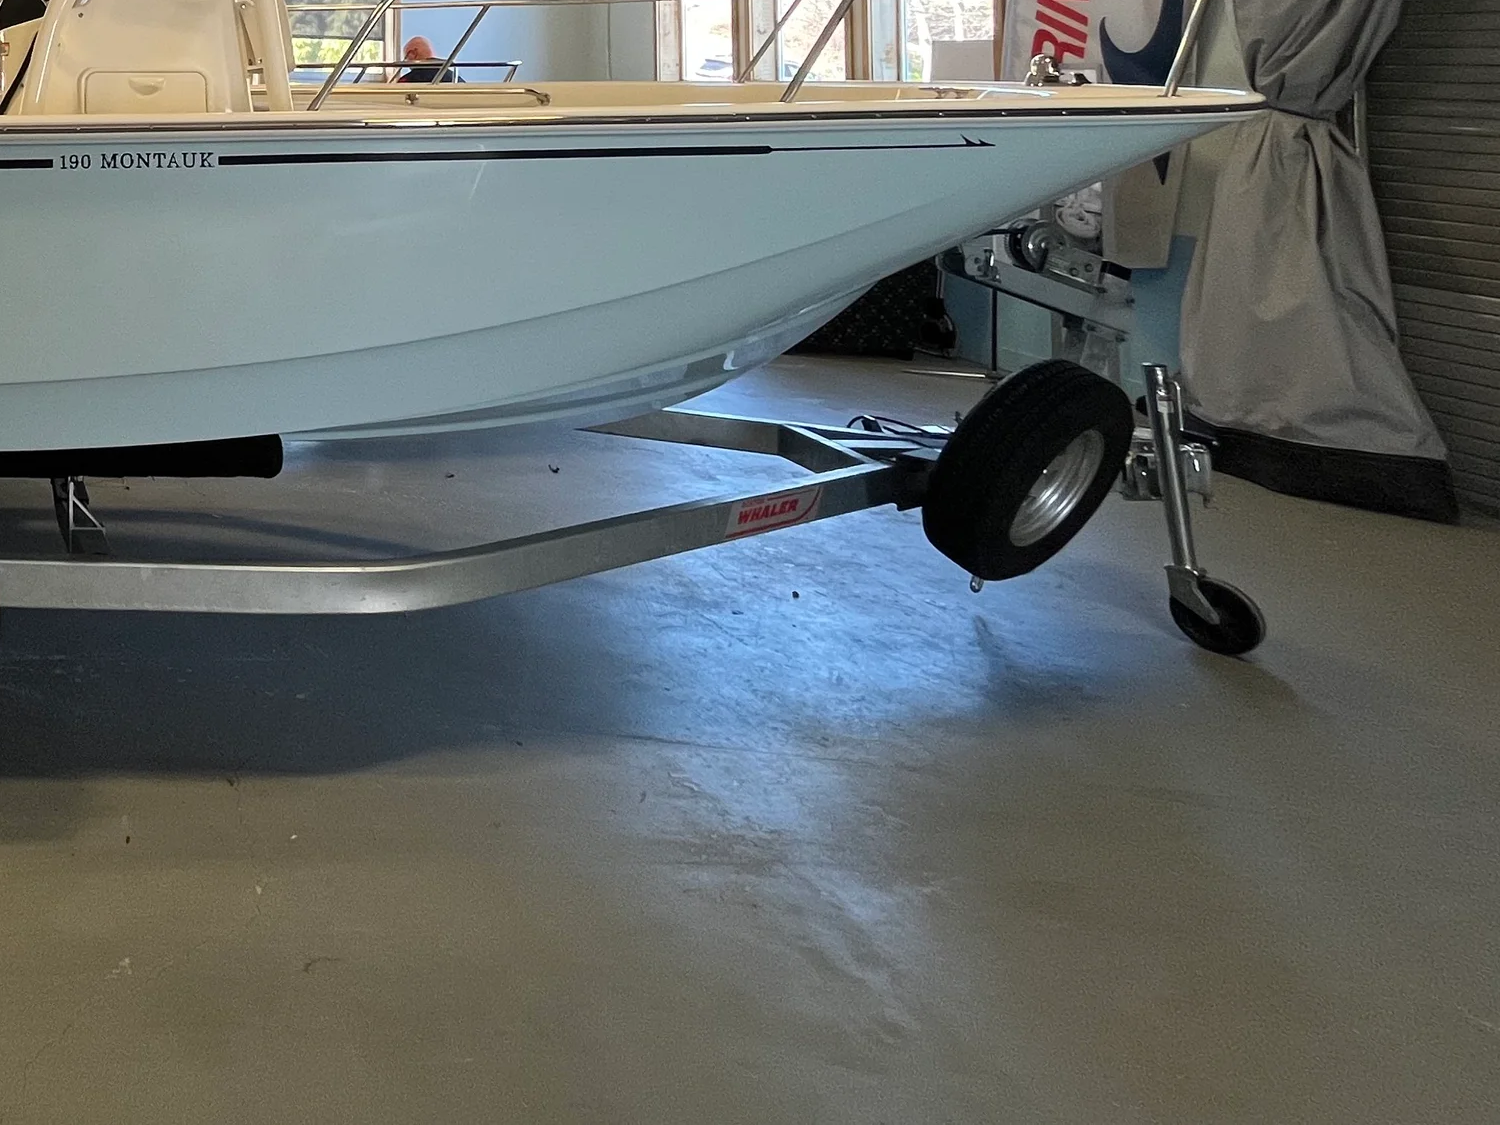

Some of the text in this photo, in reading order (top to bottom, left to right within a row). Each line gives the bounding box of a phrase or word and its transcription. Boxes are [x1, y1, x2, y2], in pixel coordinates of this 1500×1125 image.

[59, 152, 215, 169] 190 MONTAUK
[737, 498, 800, 525] WHALER
